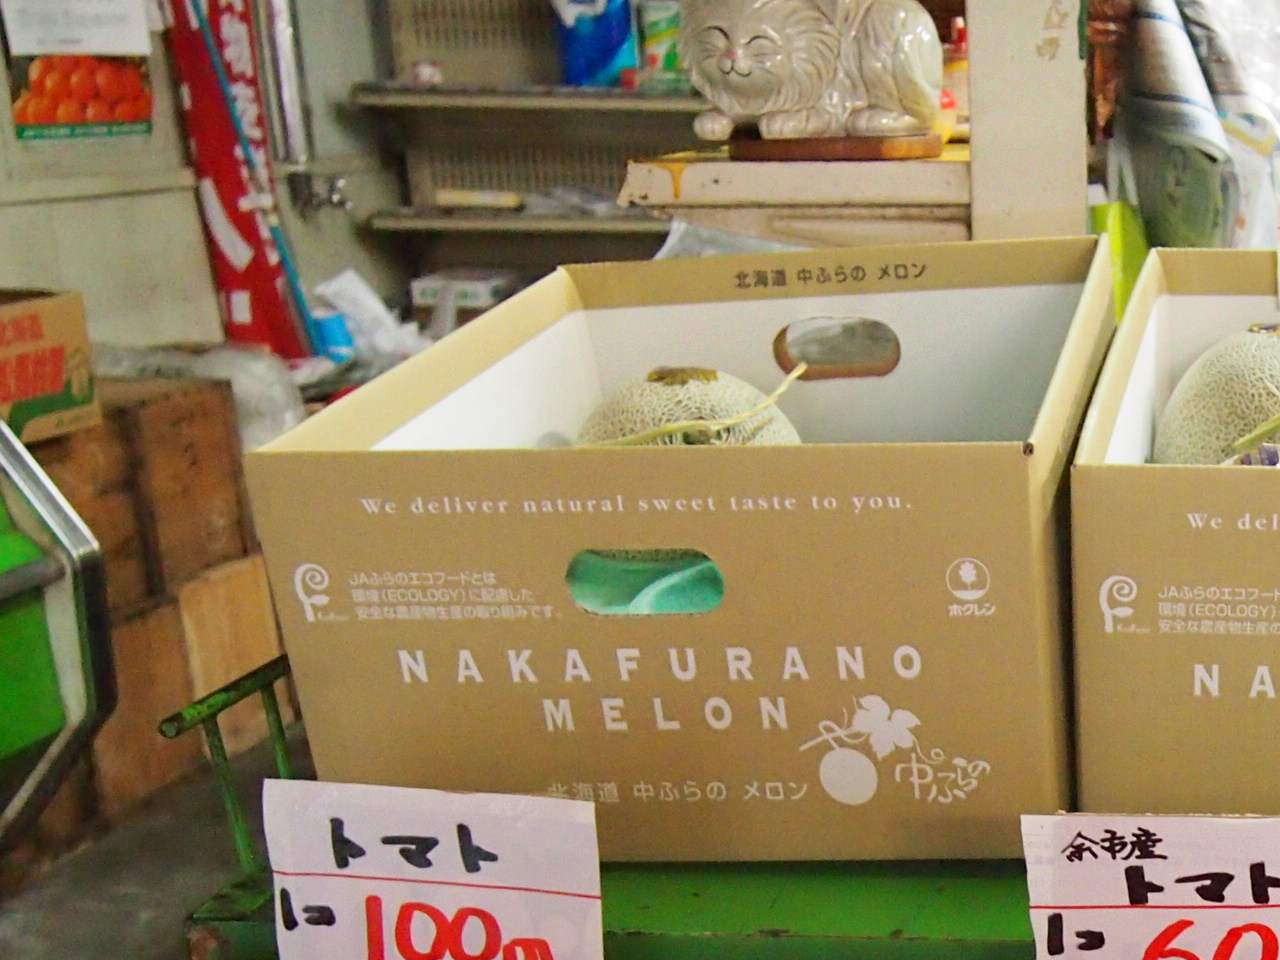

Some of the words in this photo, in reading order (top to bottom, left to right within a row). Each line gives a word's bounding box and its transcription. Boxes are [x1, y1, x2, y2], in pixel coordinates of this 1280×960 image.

[733, 268, 788, 289] 北海道
[796, 264, 867, 285] 中ふらの
[877, 263, 927, 281] メロン
[359, 497, 397, 515] We
[410, 495, 508, 514] deliver
[522, 495, 625, 513] natural
[637, 495, 717, 512] sweet
[730, 495, 798, 512] taste
[810, 493, 838, 511] to
[851, 494, 913, 513] you.
[1186, 512, 1223, 530] We
[948, 602, 996, 617] ホクレン
[397, 644, 923, 684] NAKAFURANO
[542, 695, 789, 732] MELON
[632, 779, 728, 802] 中ふらの
[743, 781, 808, 801] メロン
[329, 816, 500, 874] トマト
